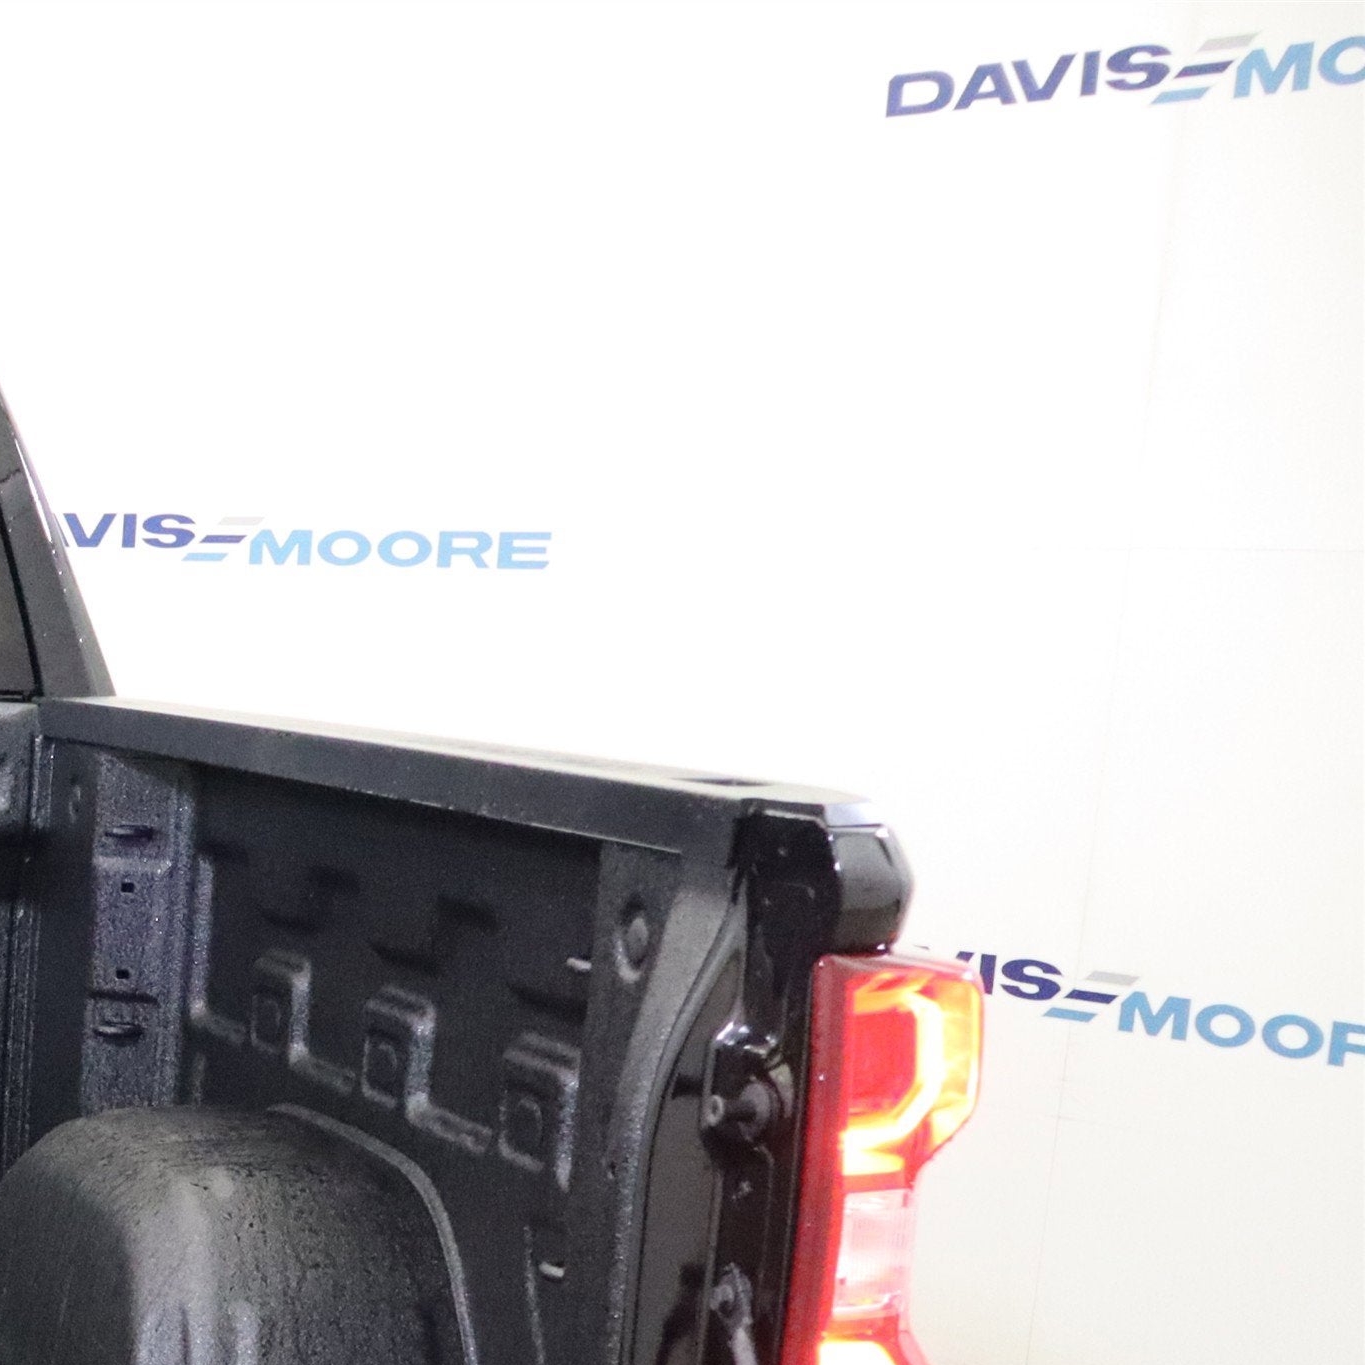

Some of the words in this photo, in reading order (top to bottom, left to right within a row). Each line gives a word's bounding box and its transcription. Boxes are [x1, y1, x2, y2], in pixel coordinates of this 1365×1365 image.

[886, 44, 1172, 117] DAVIS
[53, 513, 196, 548] VIS
[249, 528, 552, 570] MOORE
